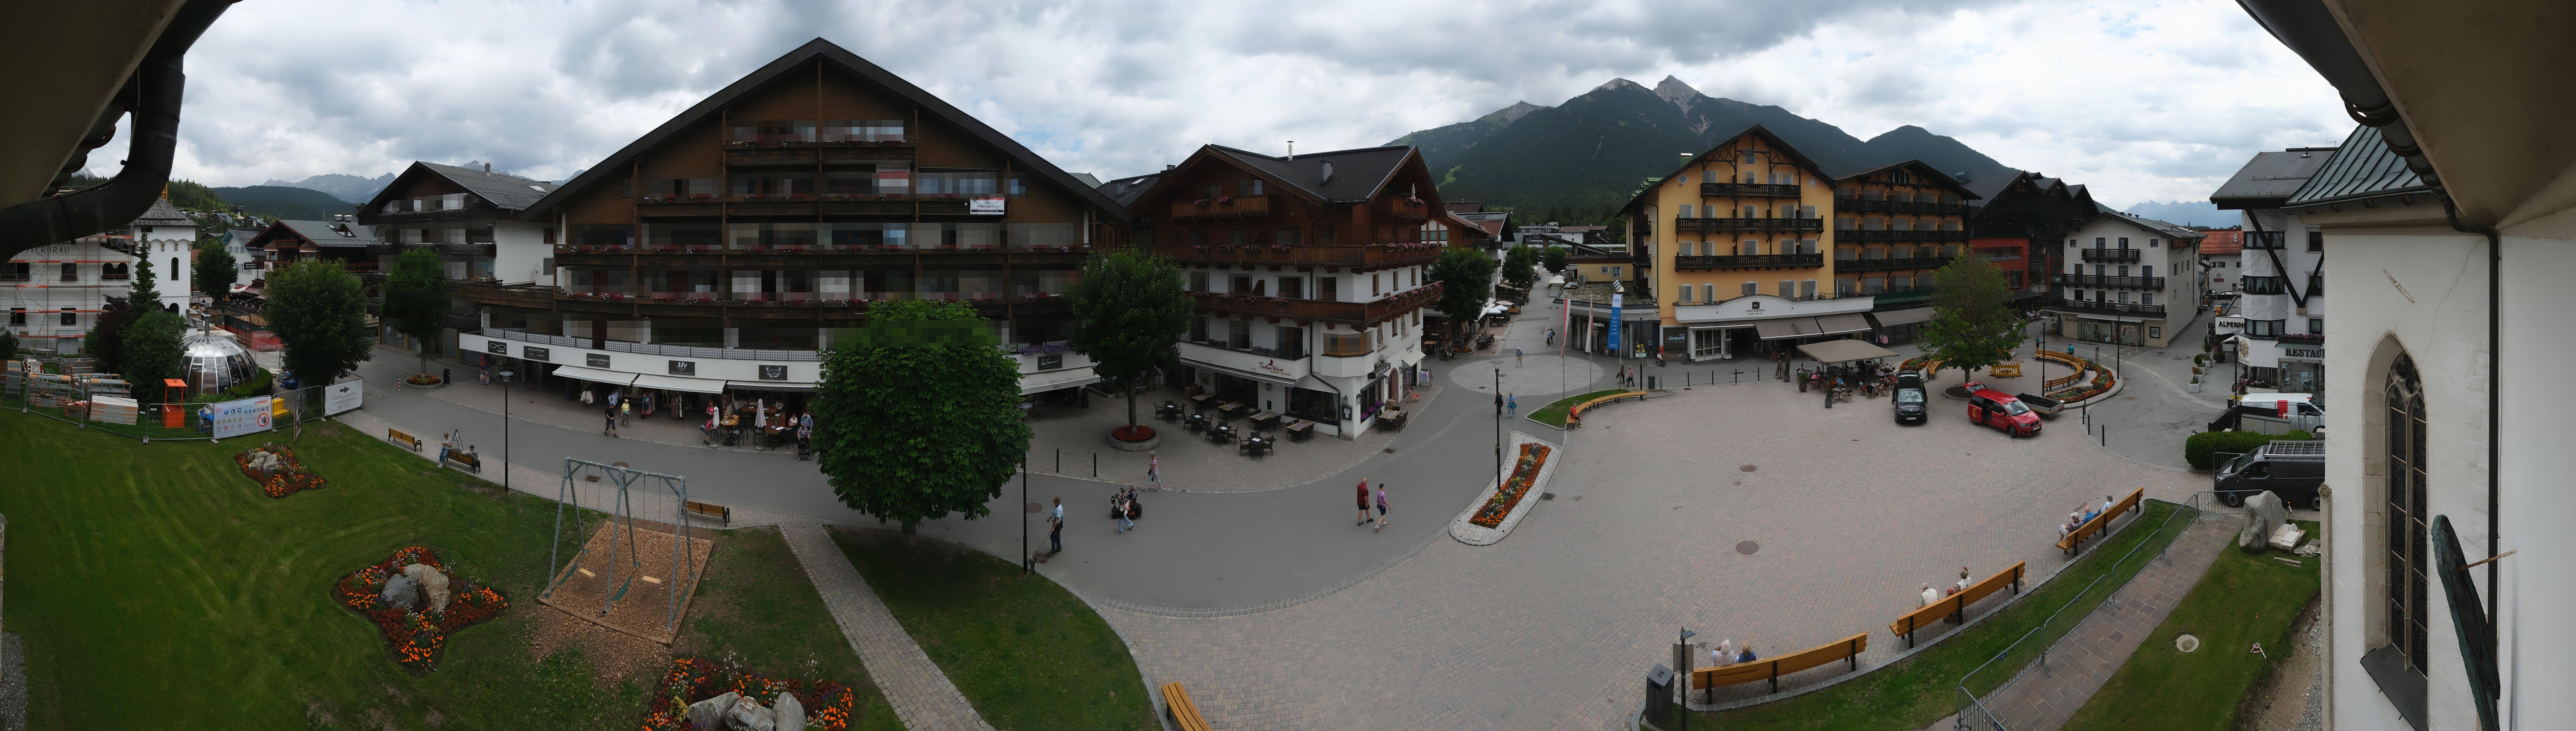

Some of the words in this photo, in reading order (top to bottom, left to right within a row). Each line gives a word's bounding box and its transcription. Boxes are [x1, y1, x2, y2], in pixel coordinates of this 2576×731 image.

[1406, 343, 1414, 352] SAILER
[676, 362, 688, 371] My
[1376, 364, 1389, 377] RESTAURANT
[332, 397, 356, 405] KONGRESSZENTRUM
